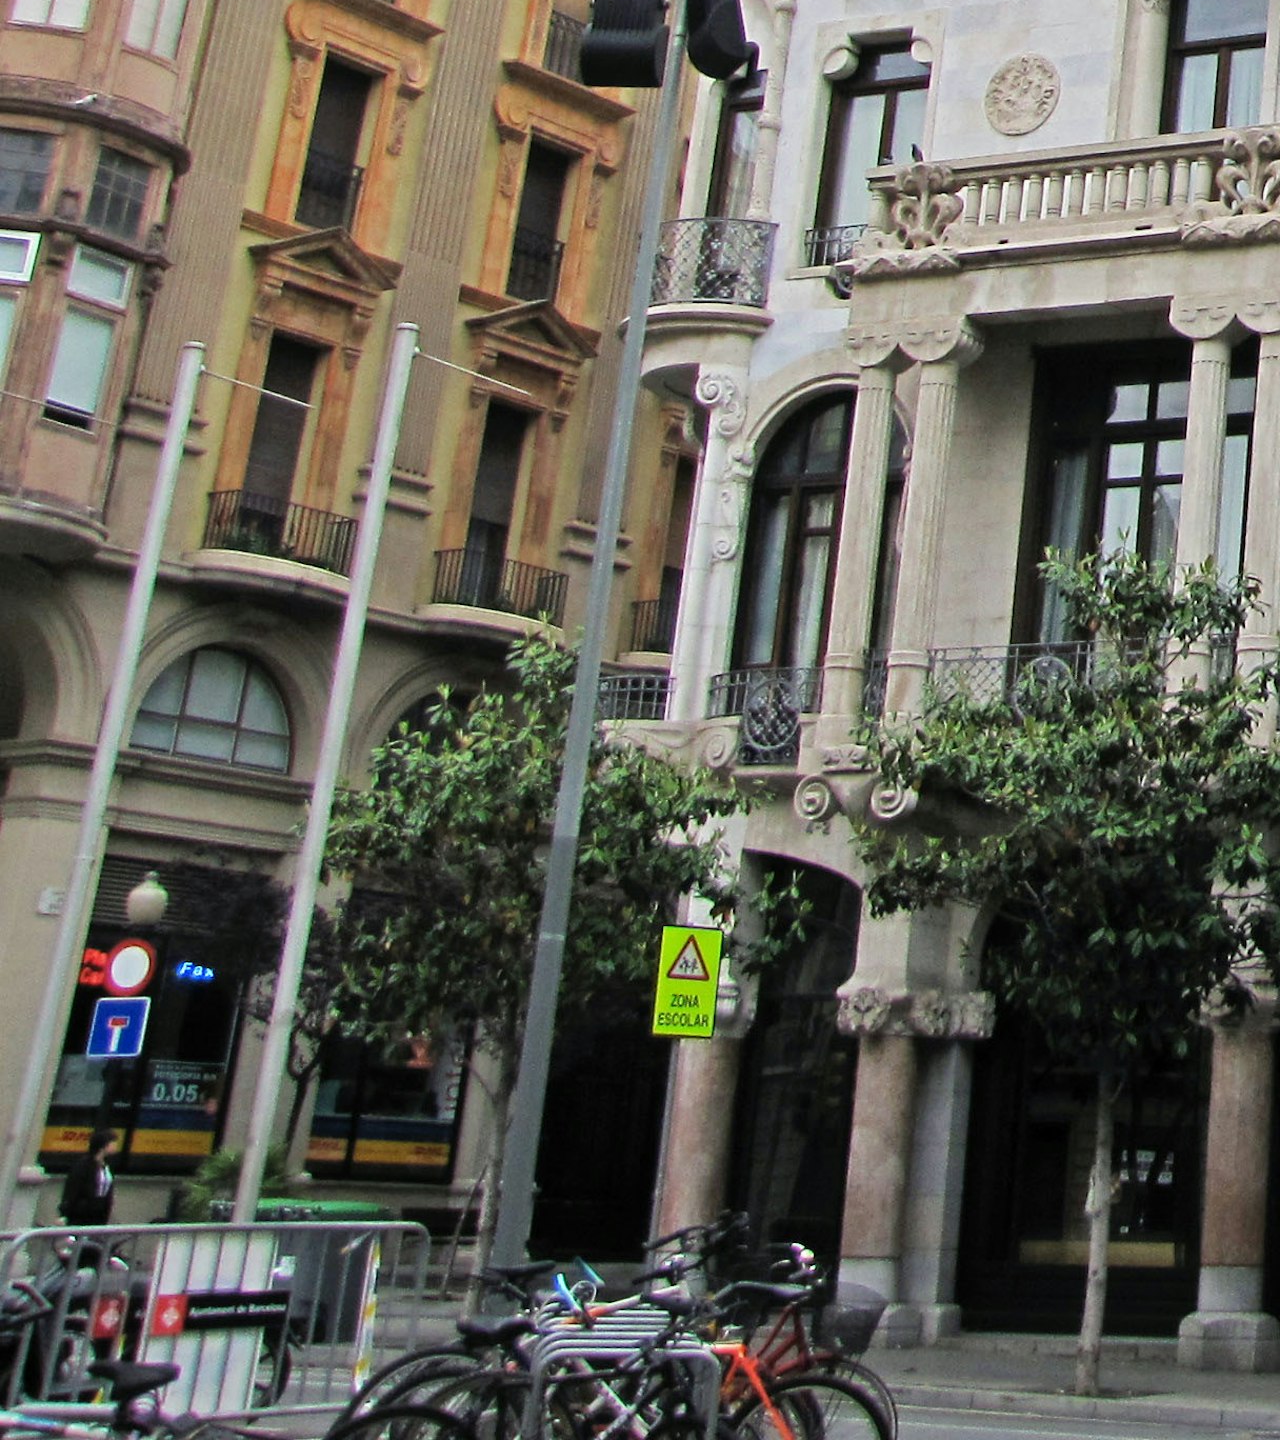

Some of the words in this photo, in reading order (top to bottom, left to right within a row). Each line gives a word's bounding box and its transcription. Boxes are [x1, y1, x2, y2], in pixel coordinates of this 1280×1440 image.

[179, 961, 215, 977] Fax
[670, 993, 700, 1008] ZONA
[658, 1012, 709, 1027] ESCOLAR
